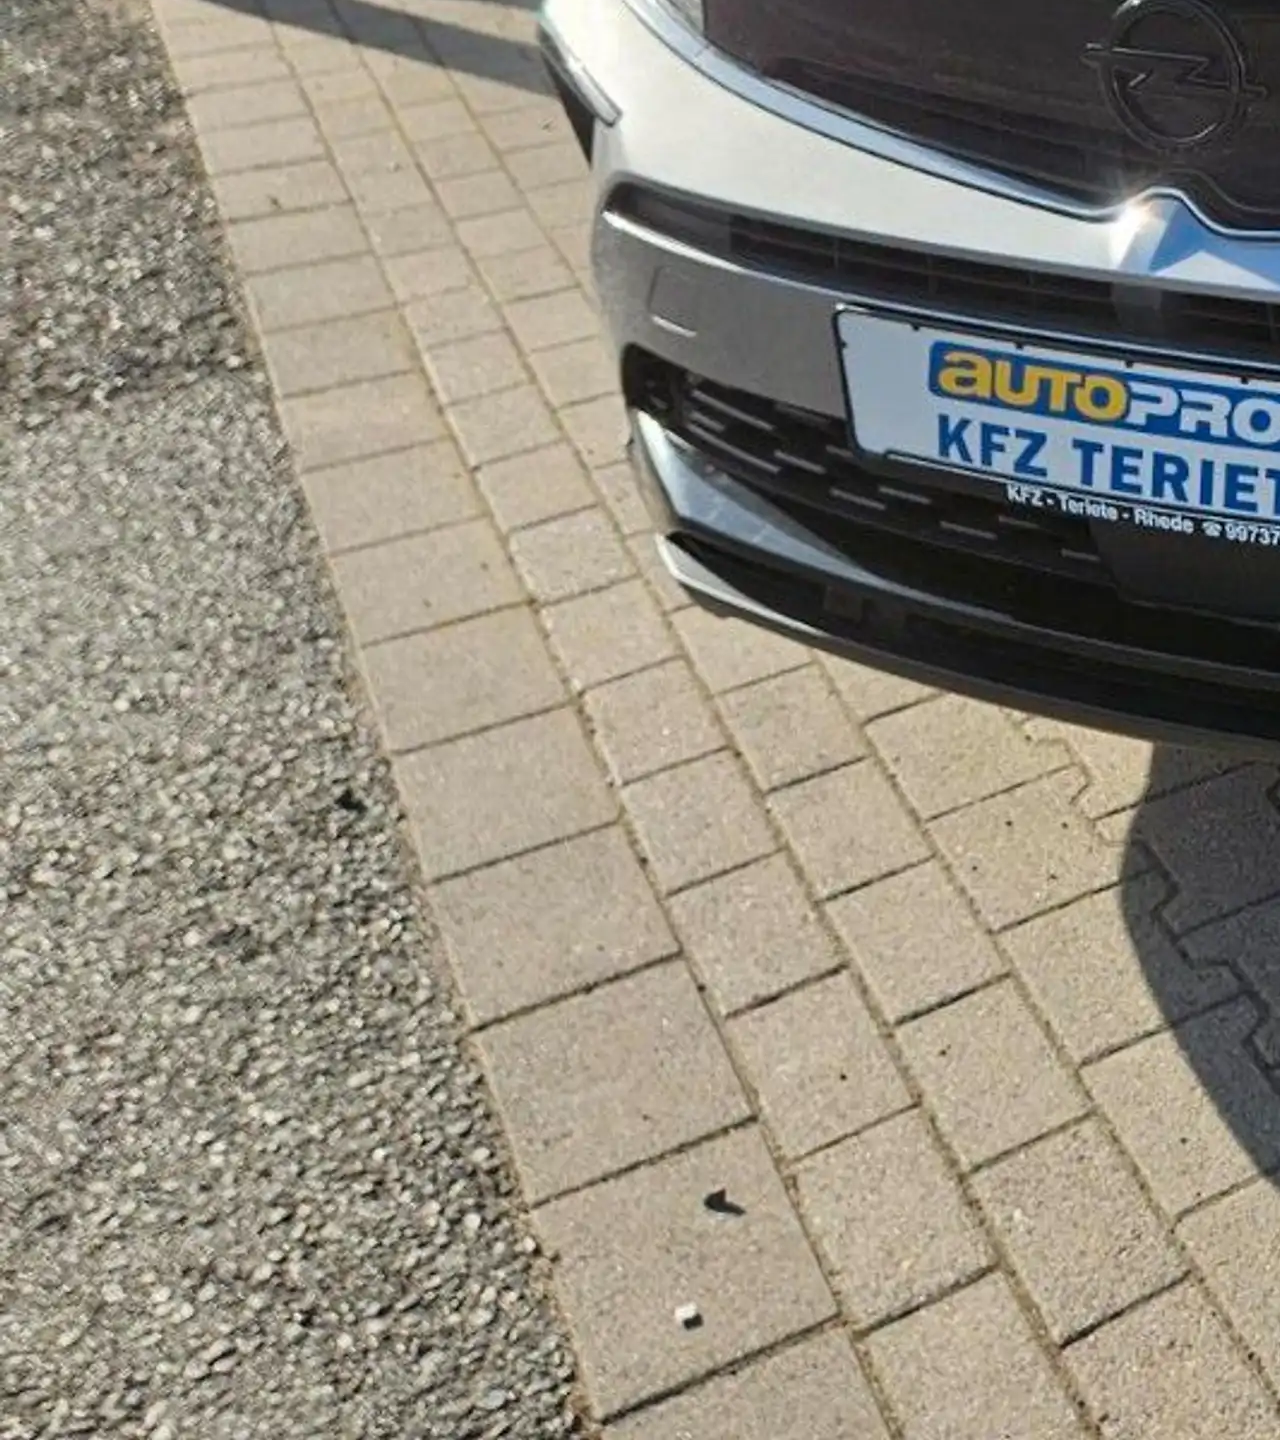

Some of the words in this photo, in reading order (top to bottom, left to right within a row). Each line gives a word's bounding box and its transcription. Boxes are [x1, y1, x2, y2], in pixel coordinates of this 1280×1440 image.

[938, 413, 1048, 478] KFZ
[1006, 483, 1044, 507] KFZ
[1059, 487, 1120, 521] Teriete
[1134, 508, 1195, 535] Rhede
